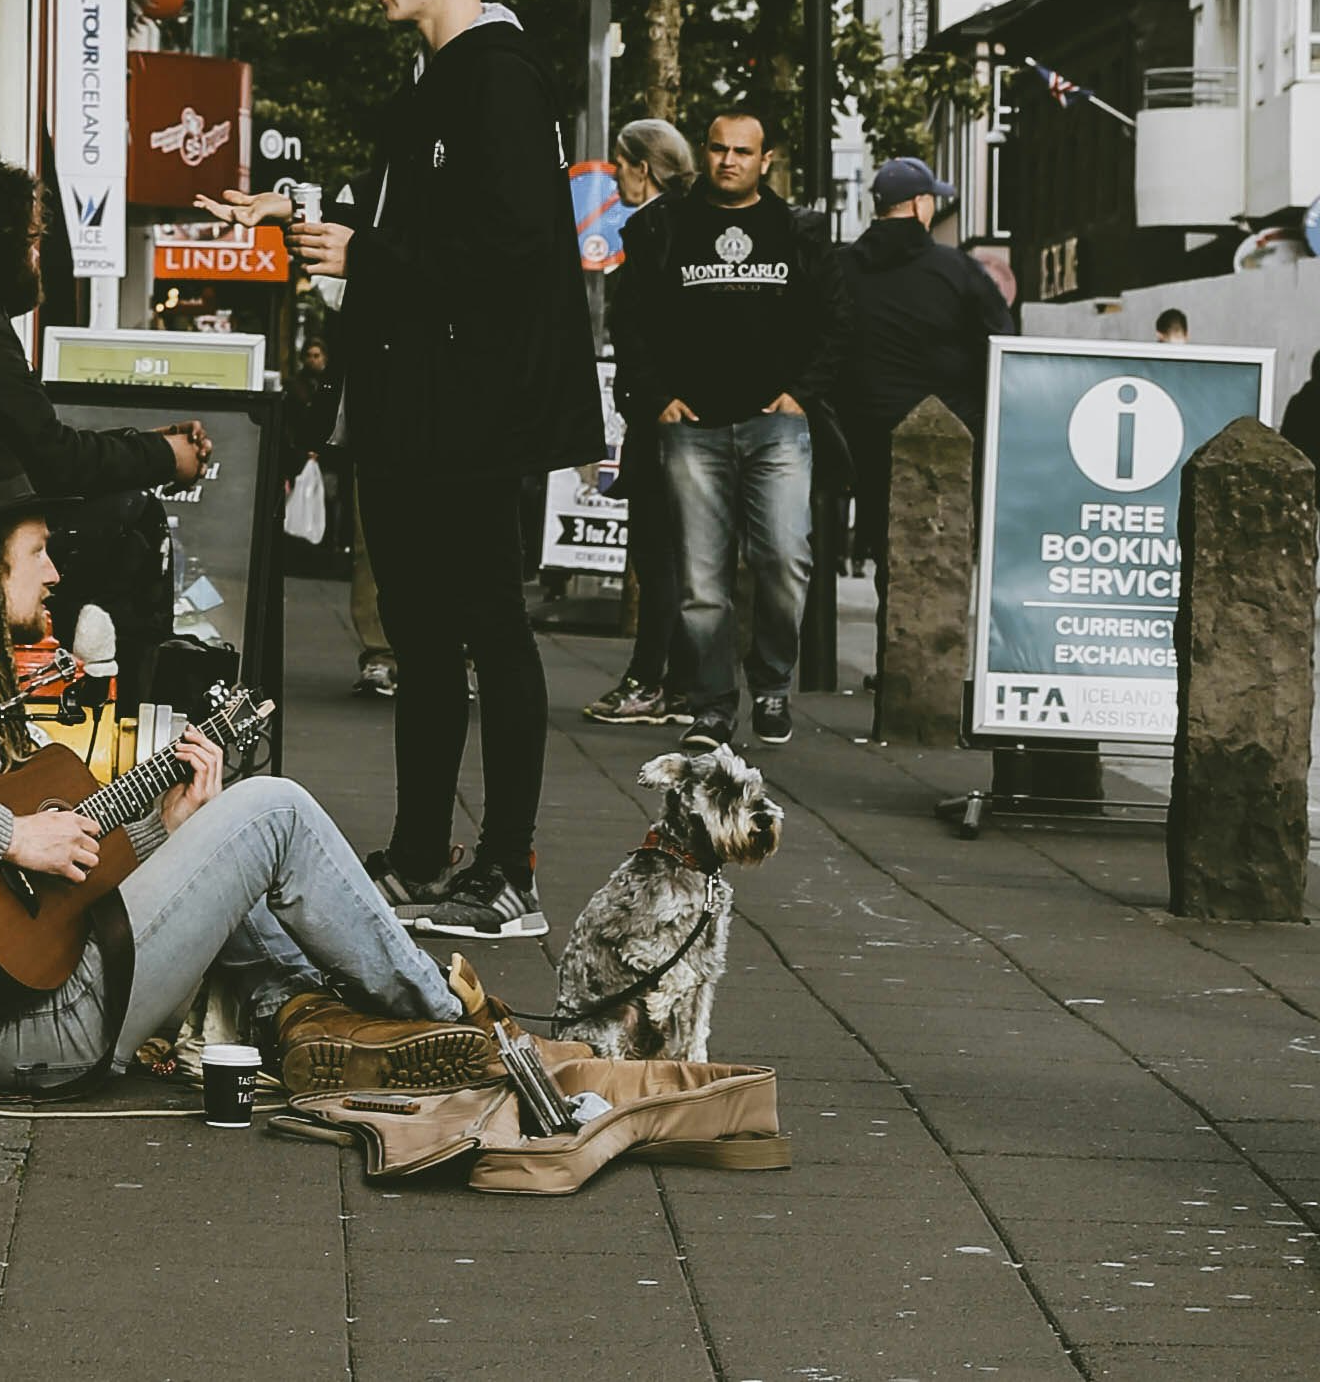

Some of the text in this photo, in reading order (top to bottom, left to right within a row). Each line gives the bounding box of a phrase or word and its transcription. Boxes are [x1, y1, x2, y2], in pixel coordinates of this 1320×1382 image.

[260, 129, 301, 160] On
[79, 229, 103, 244] ICE
[165, 248, 276, 272] LINDEX
[681, 262, 789, 281] MONTE CARLO
[1080, 503, 1166, 533] FREE
[572, 518, 585, 543] 3
[1040, 534, 1182, 566] BOOKIN
[1054, 644, 1178, 668] EXCHANGE
[996, 685, 1071, 724] ITA
[1082, 688, 1162, 707] ICELAND
